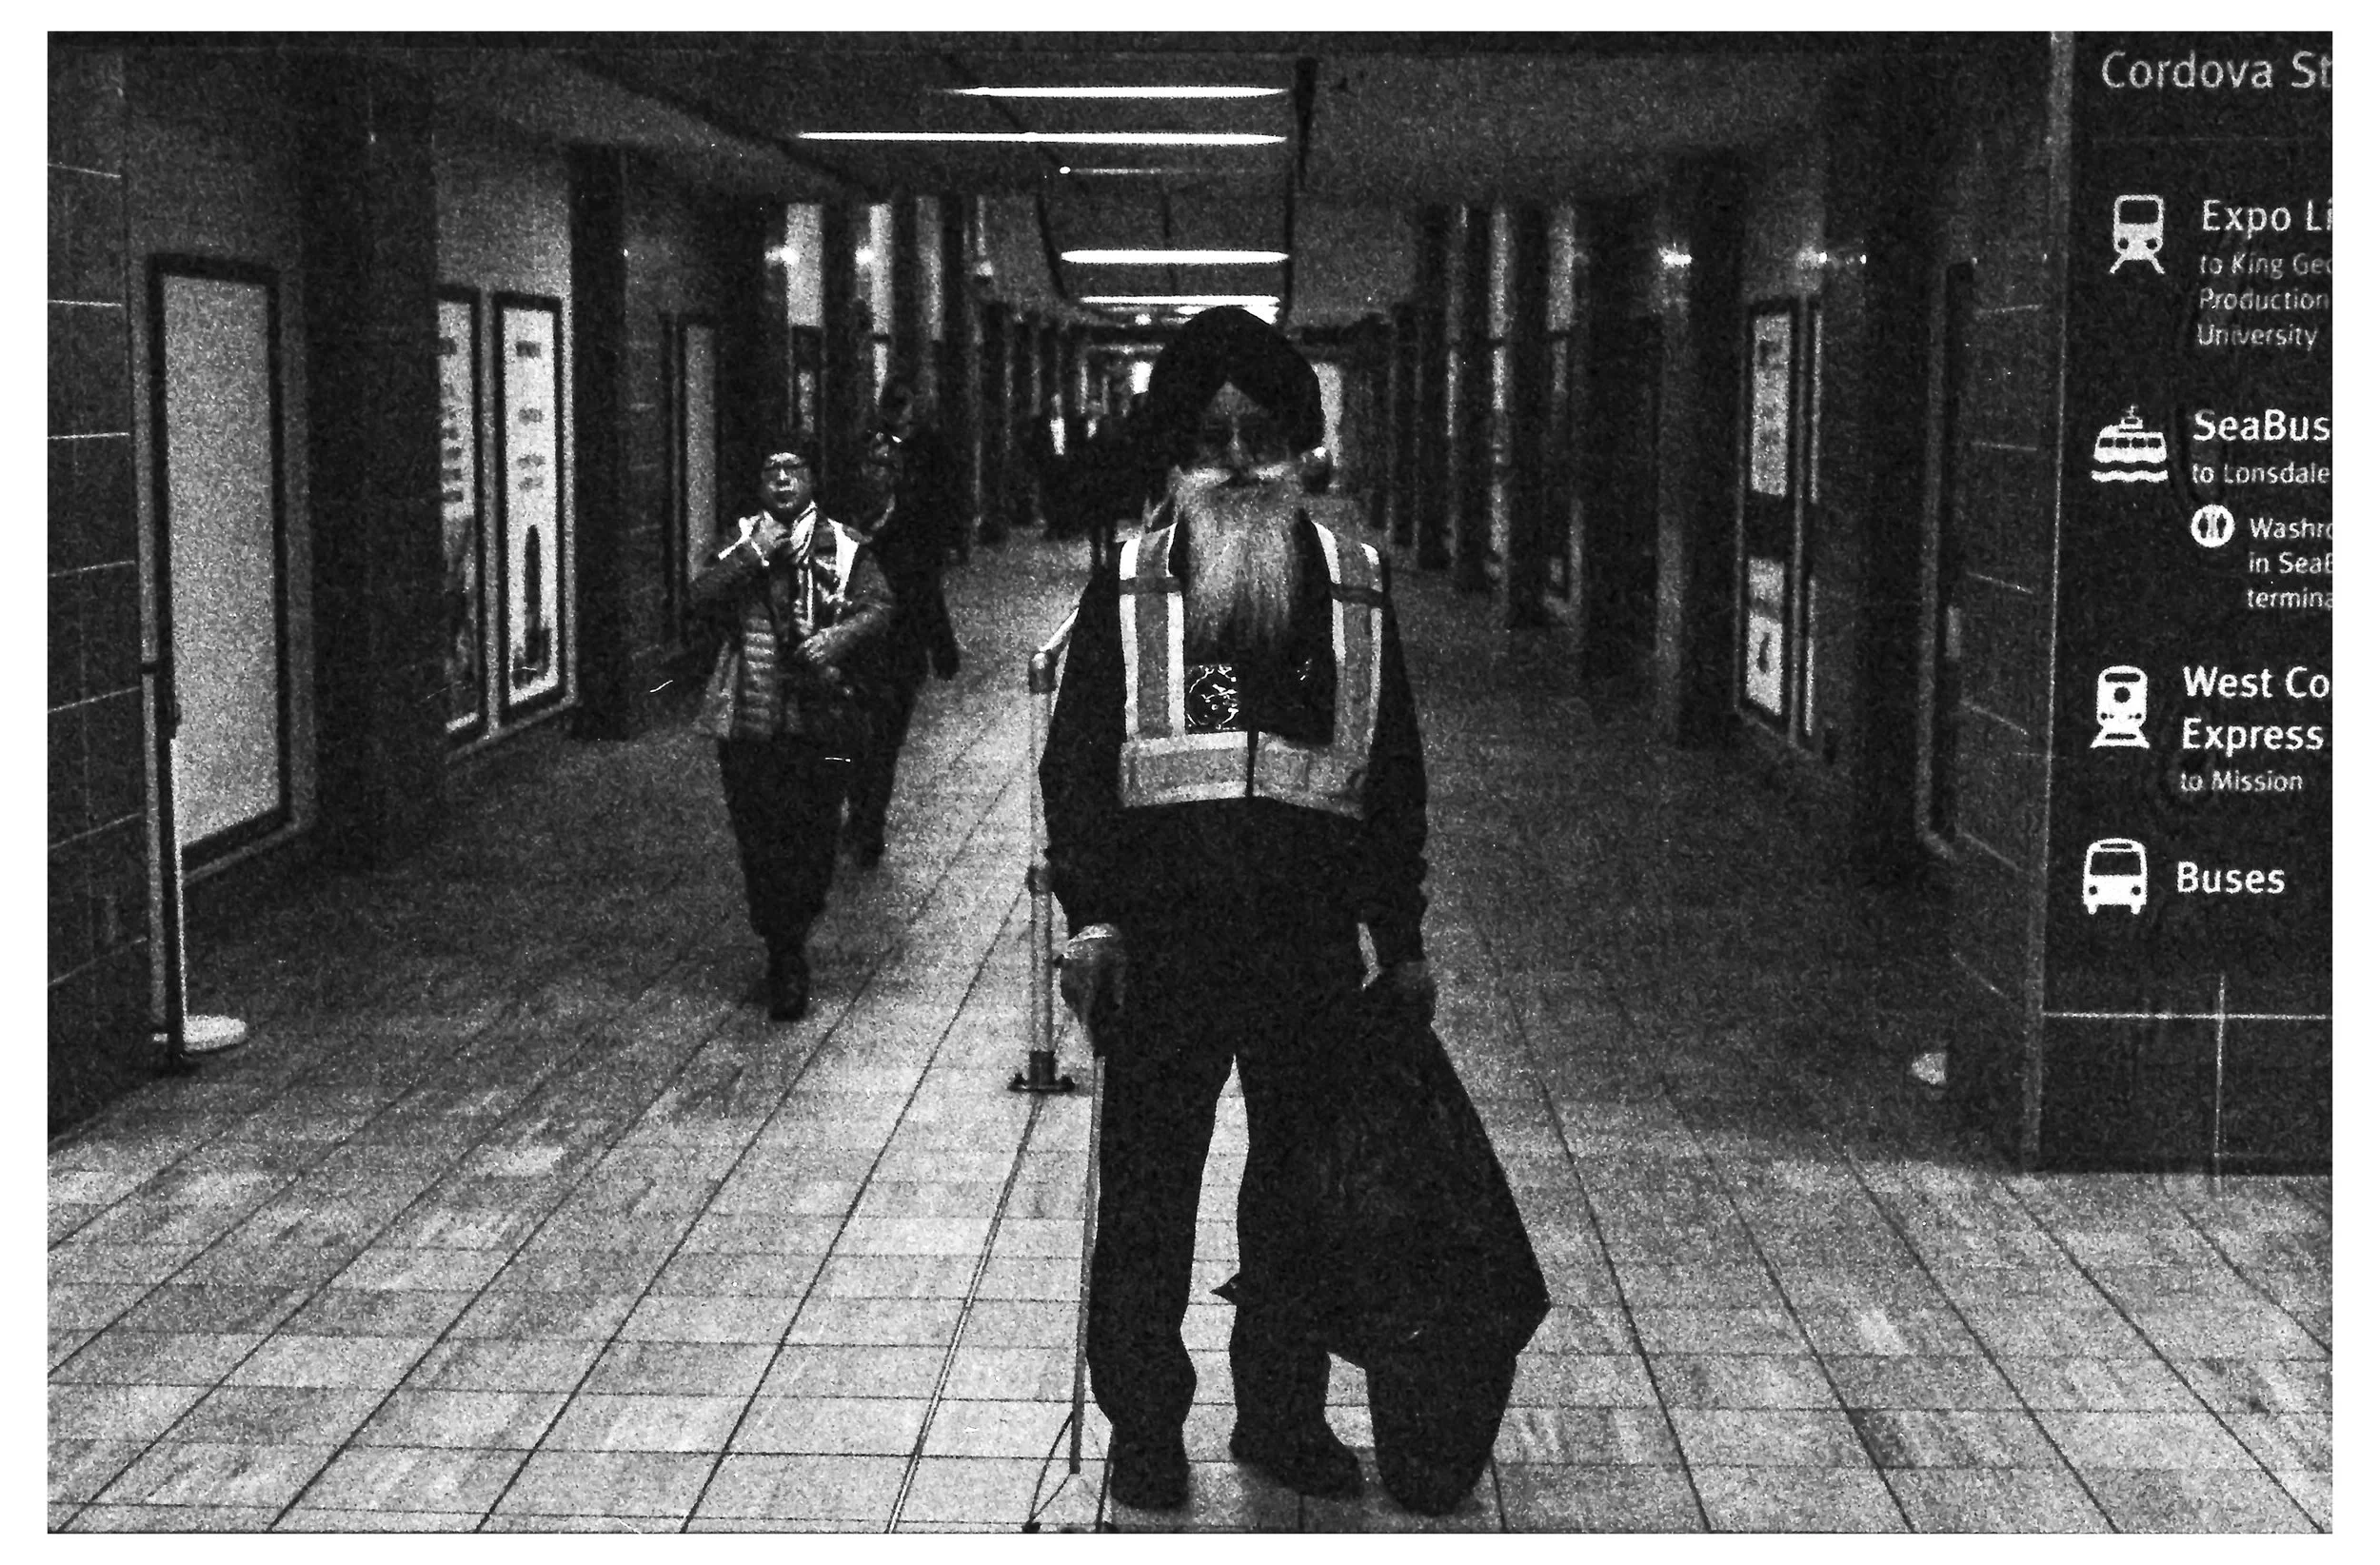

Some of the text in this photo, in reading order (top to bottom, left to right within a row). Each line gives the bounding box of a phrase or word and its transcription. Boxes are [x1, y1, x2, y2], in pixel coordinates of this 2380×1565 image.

[2101, 50, 2332, 89] Cordova St
[2202, 198, 2292, 241] Expo
[2199, 254, 2224, 276] to
[2231, 252, 2283, 280] King
[2199, 287, 2329, 311] Production
[2196, 323, 2318, 352] University
[2192, 407, 2331, 443] SeaBus
[2192, 461, 2331, 485] to Lonsdale
[2249, 551, 2271, 574] in
[2246, 586, 2332, 611] termina
[2182, 664, 2330, 700] West Co
[2181, 715, 2325, 759] Express
[2179, 768, 2304, 793] to Mission
[2176, 860, 2286, 895] Buses
